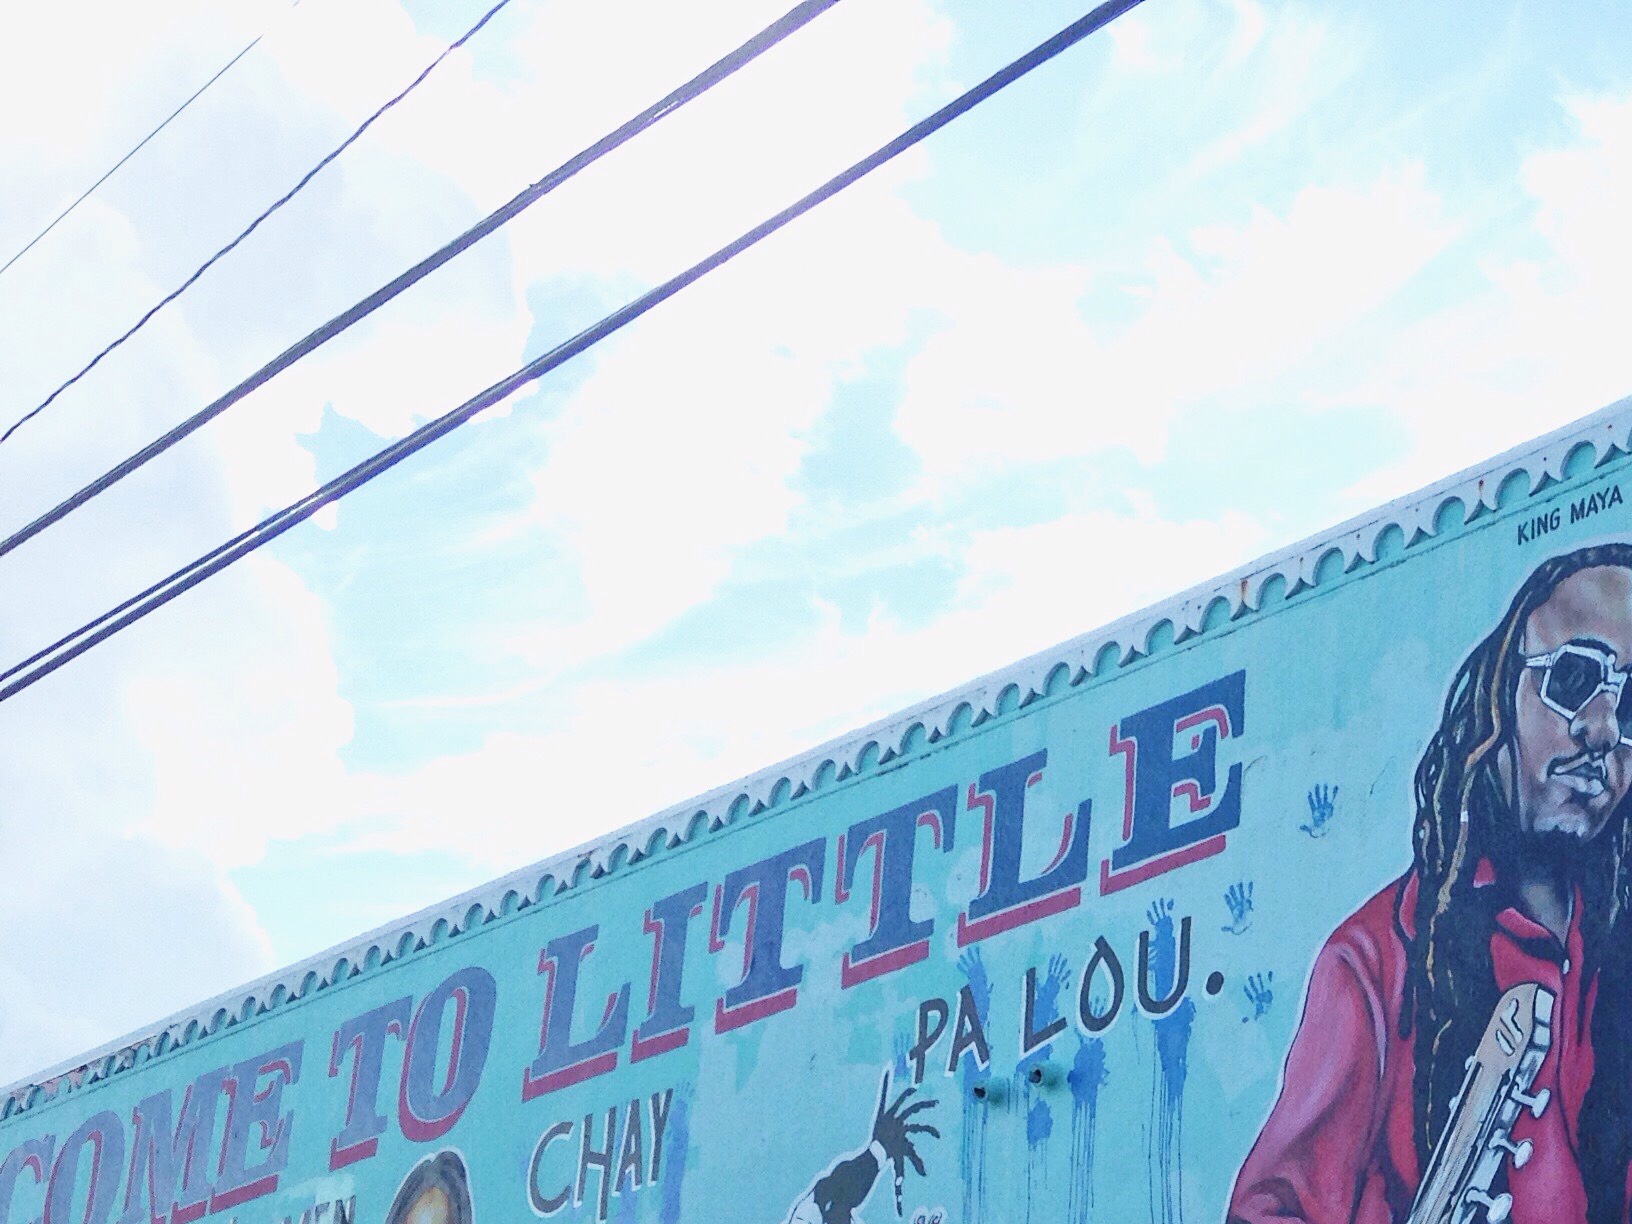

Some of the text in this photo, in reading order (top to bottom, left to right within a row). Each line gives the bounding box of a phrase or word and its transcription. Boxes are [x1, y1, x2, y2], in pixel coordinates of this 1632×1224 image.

[1517, 485, 1623, 545] KING MAYA
[327, 968, 498, 1171] TO
[522, 668, 1246, 1102] LITTLE
[526, 1088, 674, 1224] CHAY
[907, 984, 991, 1083] PA
[1018, 916, 1225, 1055] LOU.
